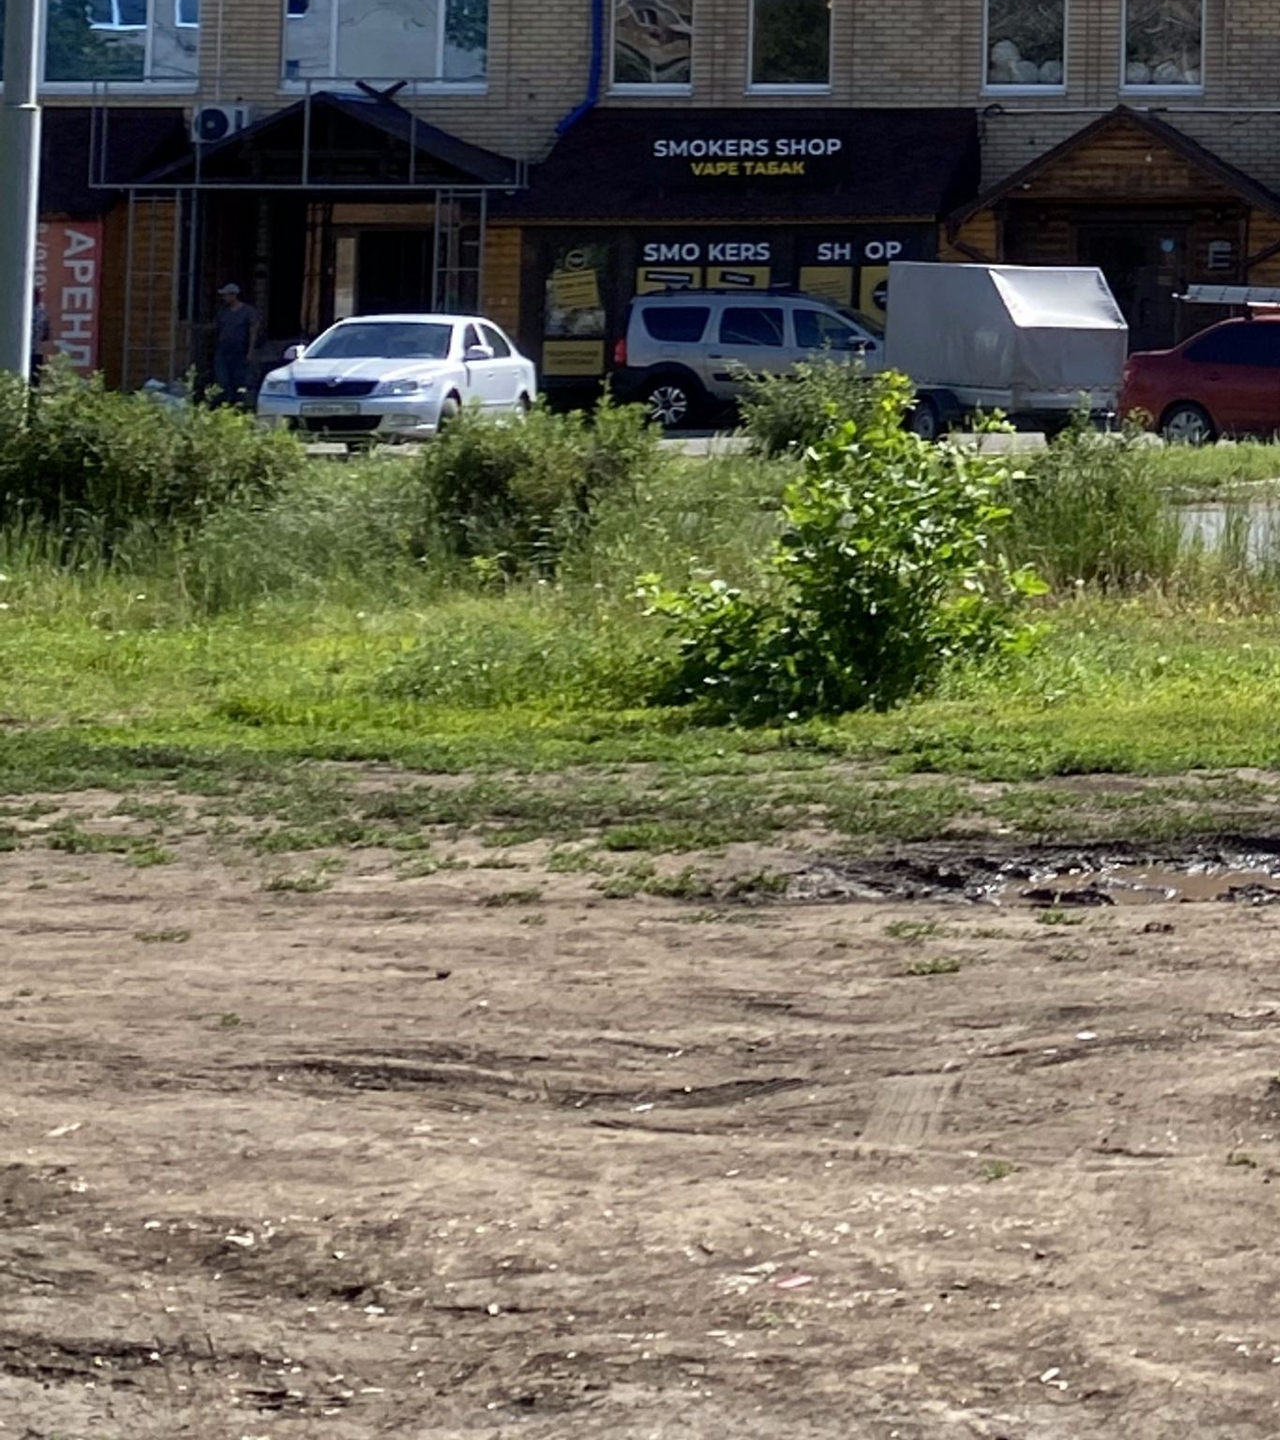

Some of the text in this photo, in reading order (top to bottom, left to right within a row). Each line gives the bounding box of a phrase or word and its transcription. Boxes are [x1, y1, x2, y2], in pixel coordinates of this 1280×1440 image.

[653, 138, 842, 157] SMOKERS SHOP
[690, 161, 805, 175] VAPE ТАБАК
[54, 229, 96, 367] АРЕНД
